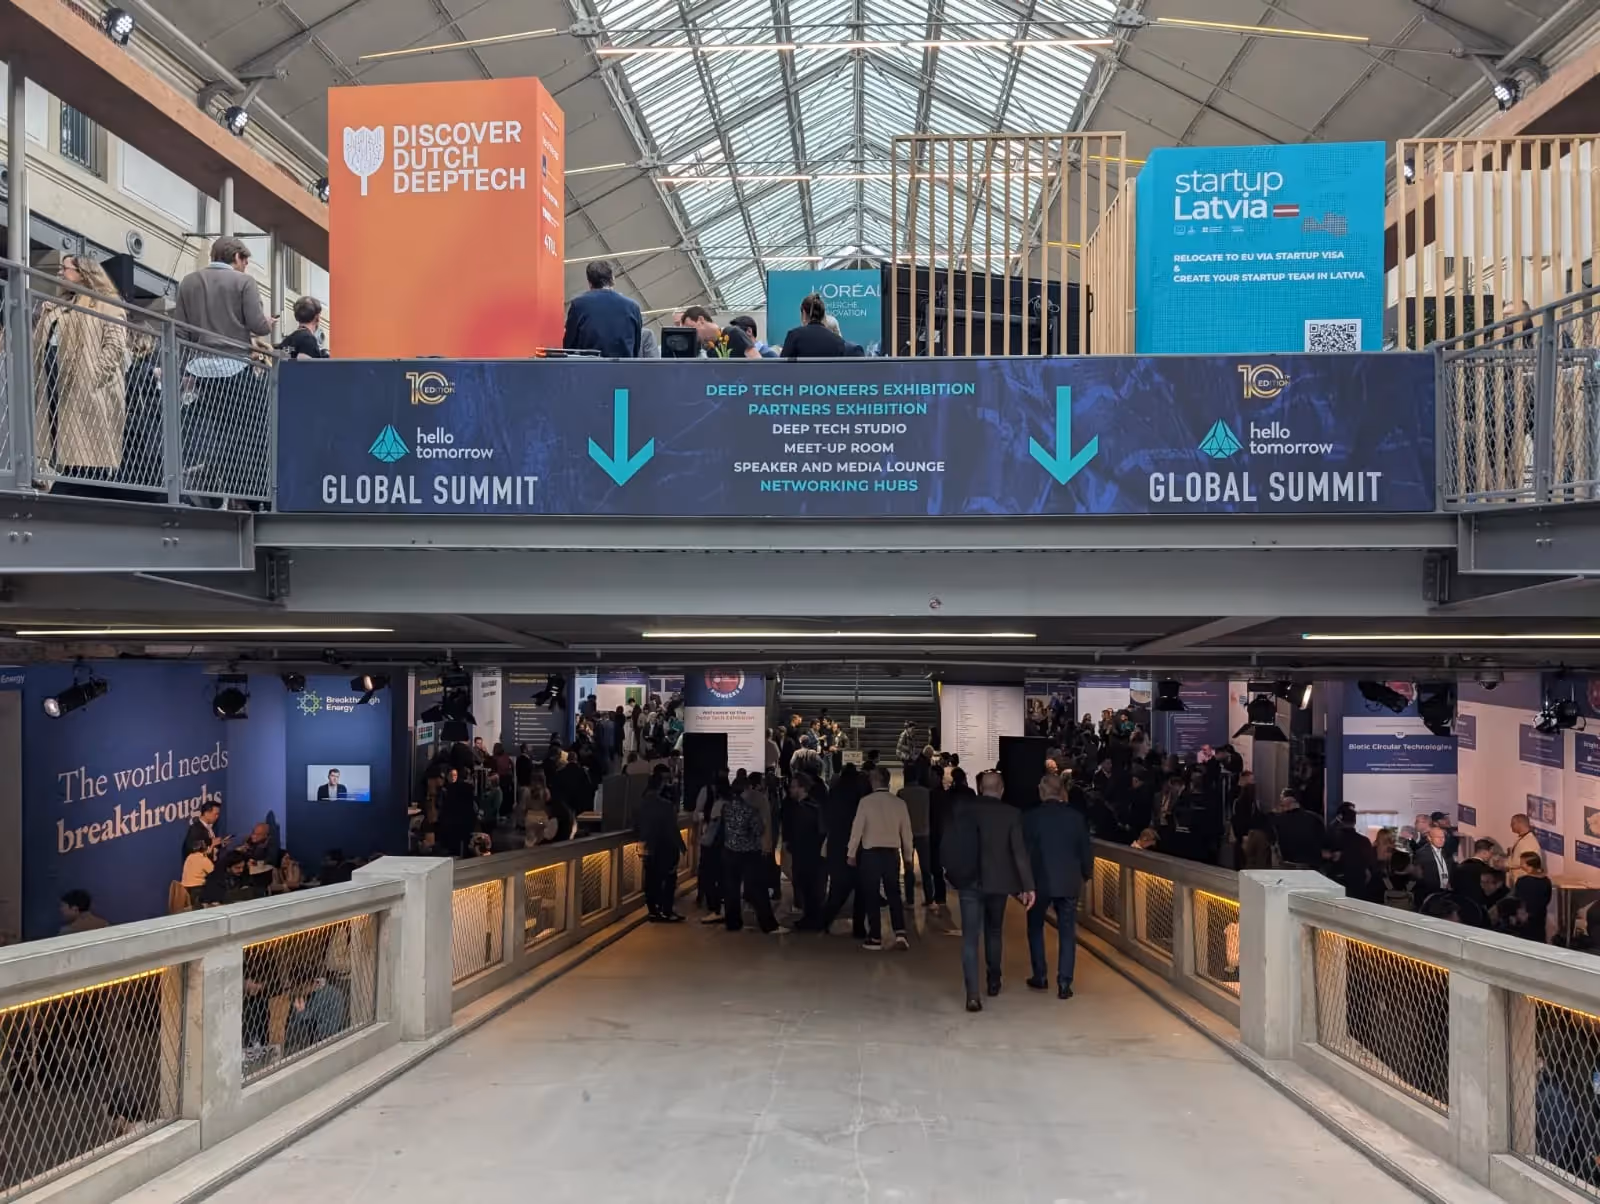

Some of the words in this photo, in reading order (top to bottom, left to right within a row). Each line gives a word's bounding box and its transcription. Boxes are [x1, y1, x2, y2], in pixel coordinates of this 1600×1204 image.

[393, 121, 522, 147] DISCOVER
[393, 145, 478, 171] DUTCH
[393, 168, 526, 194] DEEPTECH
[1175, 169, 1283, 197] startup
[1174, 192, 1268, 220] Latvia
[1174, 254, 1223, 262] RELOCATE
[1241, 253, 1254, 261] EU
[1256, 253, 1273, 261] VIA
[1275, 252, 1319, 261] STARTUP
[1322, 251, 1344, 259] VISA
[1174, 274, 1210, 282] CREATE
[1242, 273, 1285, 281] STARTUP
[1288, 272, 1315, 281] TEAM
[1317, 272, 1328, 280] IN
[1330, 271, 1364, 280] LATVIA
[706, 385, 748, 397] DEEP
[752, 385, 793, 396] TECH
[799, 384, 878, 396] PIONEERS
[883, 383, 975, 395] EXHIBITION
[749, 404, 831, 416] PARTNERS
[836, 403, 927, 415] EXHIBITION
[416, 427, 454, 444] hello
[772, 424, 810, 434] DEEP
[813, 424, 850, 434] TECH
[854, 423, 907, 434] STUDIO
[1250, 421, 1290, 439] hello
[416, 445, 494, 460] tomorrow
[784, 443, 847, 453] MEET-UP
[851, 443, 894, 453] ROOM
[1249, 440, 1333, 454] tomorrow
[734, 462, 798, 473] SPEAKER
[801, 462, 832, 473] AND
[836, 462, 883, 472] MEDIA
[886, 461, 945, 472] LOUNGE
[322, 475, 422, 504] GLOBAL
[434, 475, 539, 505] SUMMIT
[760, 480, 868, 492] NETWORKING
[874, 480, 918, 491] HUBS
[1150, 472, 1257, 502] GLOBAL
[1269, 471, 1382, 502] SUMMIT
[326, 696, 380, 705] Breakthrgh
[326, 704, 354, 712] Energy
[58, 766, 108, 804] The
[113, 750, 173, 792] world
[178, 741, 229, 778] needs
